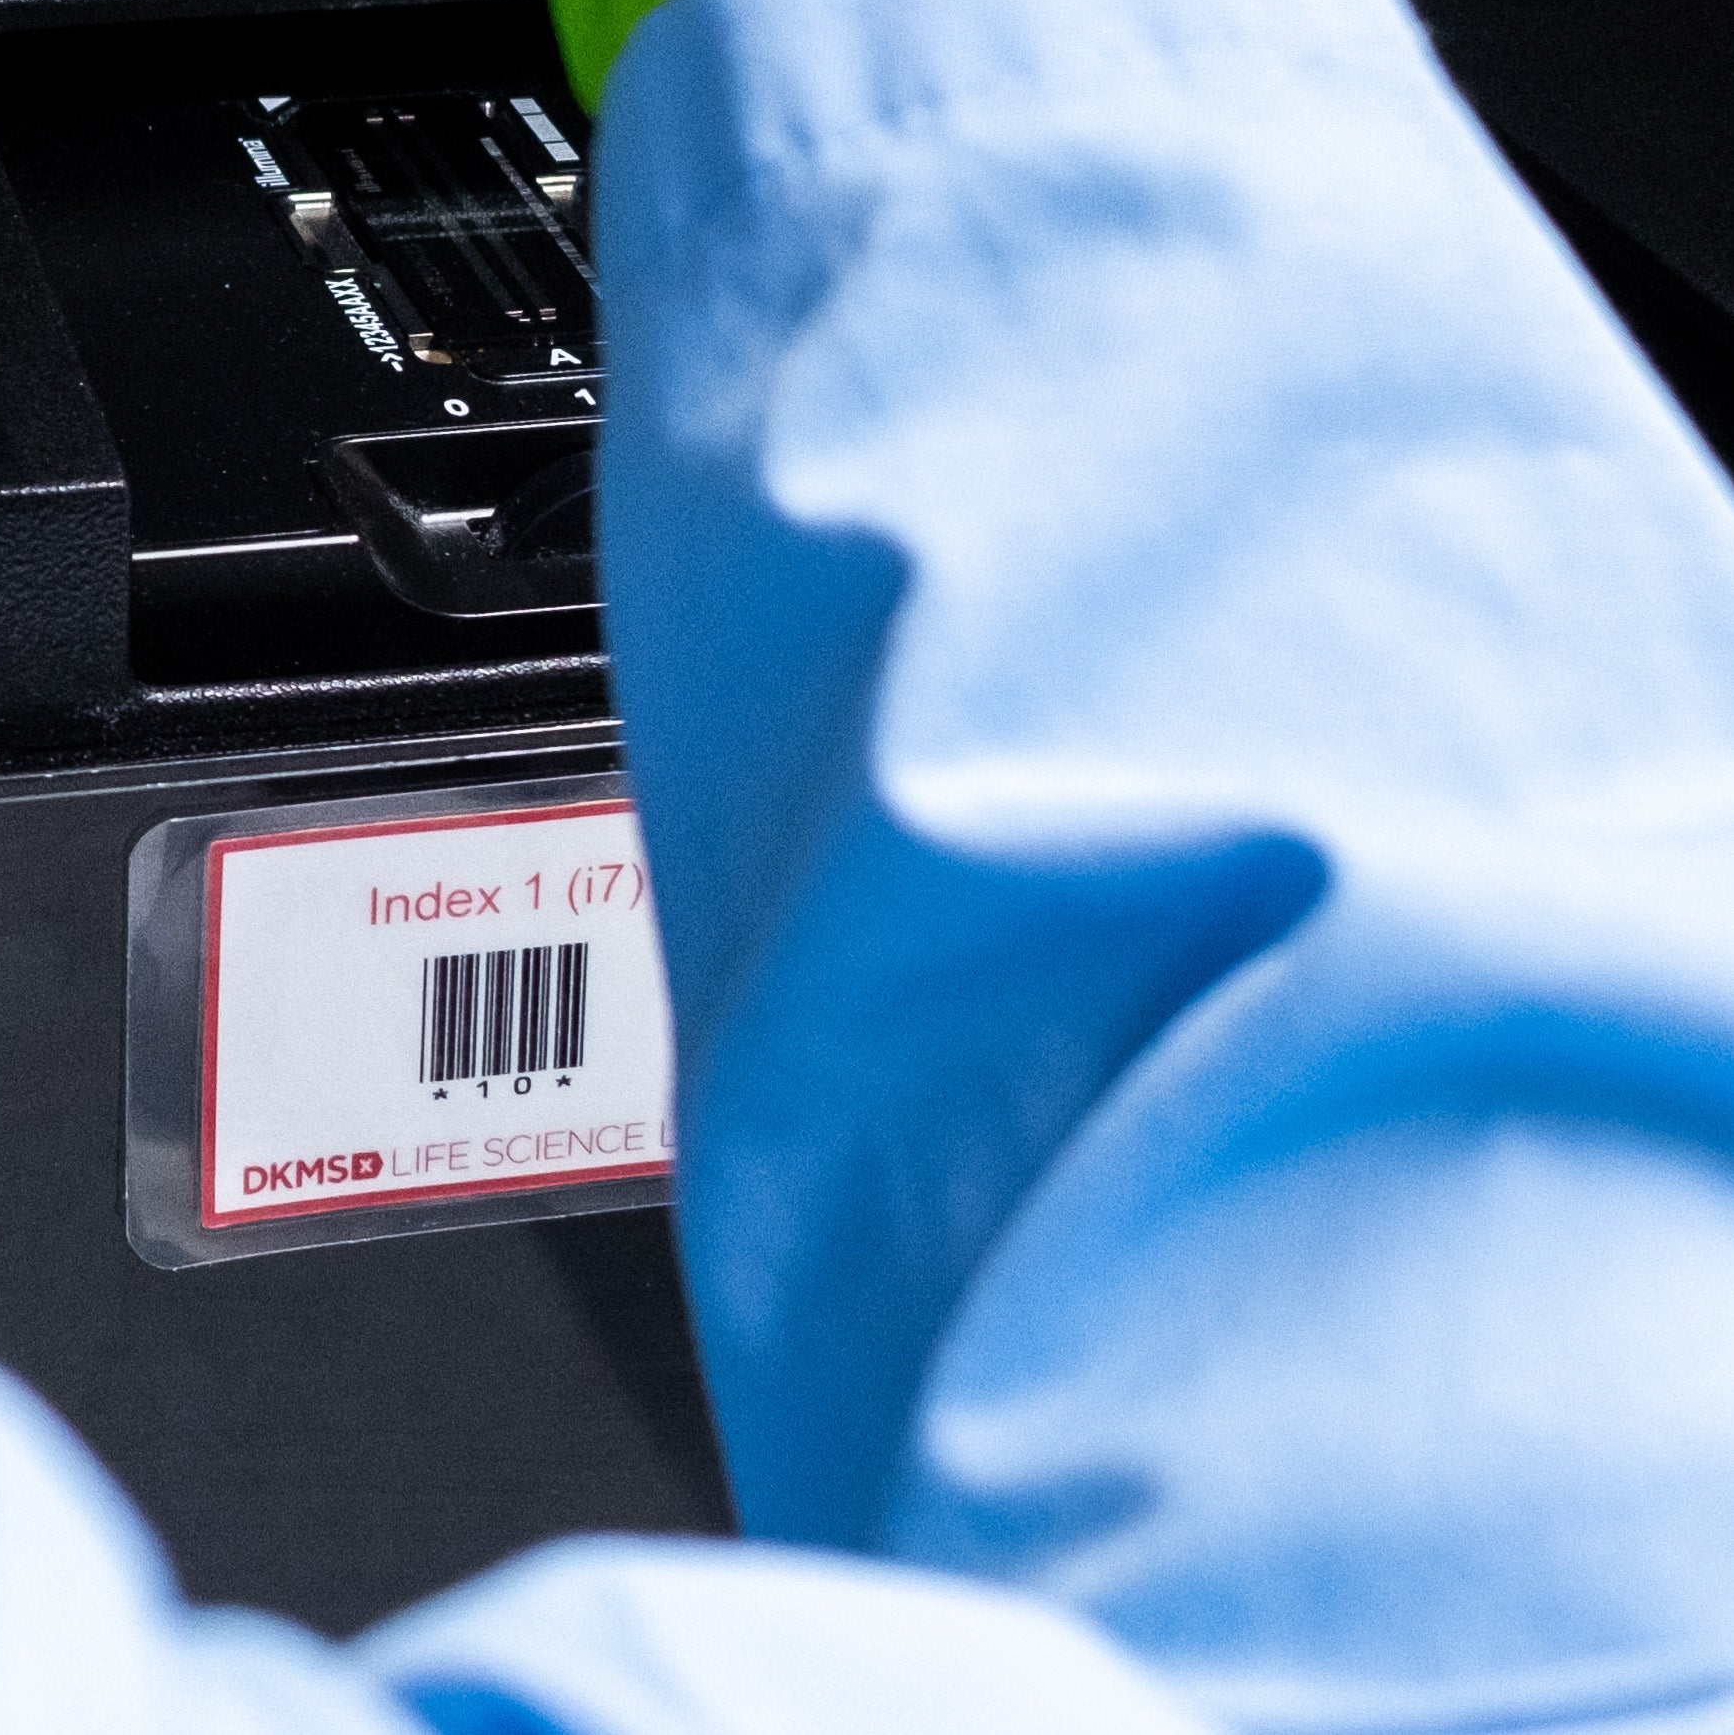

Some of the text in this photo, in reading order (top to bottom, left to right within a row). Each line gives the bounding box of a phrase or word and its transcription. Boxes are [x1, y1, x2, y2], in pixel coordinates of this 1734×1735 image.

[551, 349, 581, 366] A
[371, 863, 644, 925] Index 1 (i7)
[243, 1153, 348, 1196] DKMS
[392, 1141, 469, 1176] LIFE
[483, 1121, 646, 1167] SCIENCE
